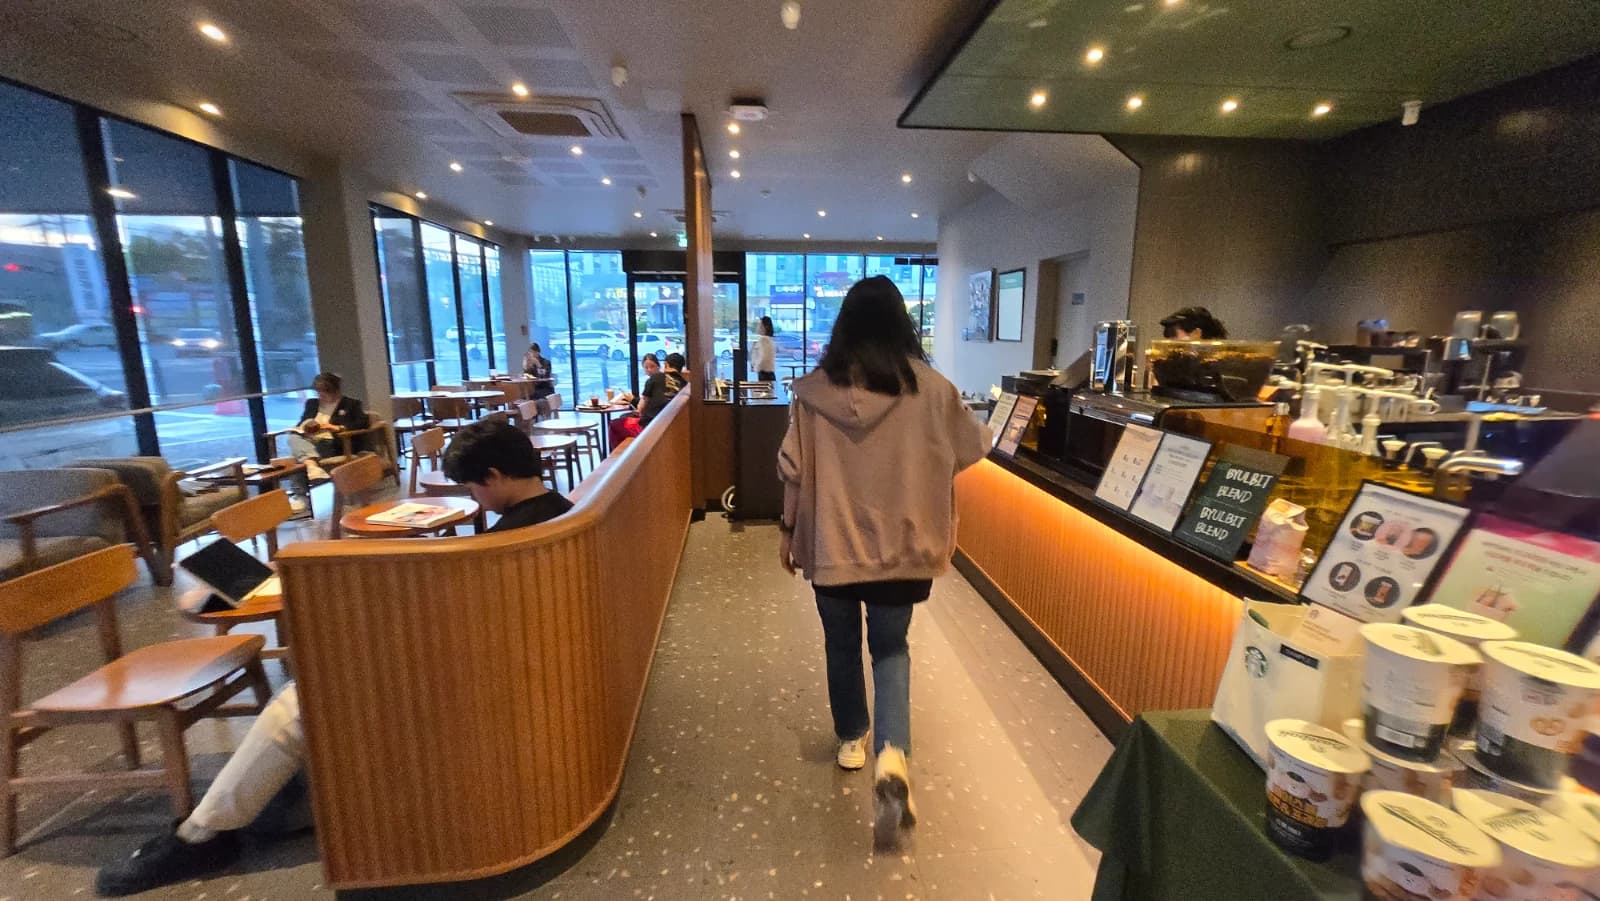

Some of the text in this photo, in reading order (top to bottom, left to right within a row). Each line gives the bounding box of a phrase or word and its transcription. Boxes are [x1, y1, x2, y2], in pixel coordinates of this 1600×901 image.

[1226, 468, 1273, 488] BYULBIT
[1216, 485, 1252, 503] BLEND
[1200, 506, 1247, 528] BYULBIT
[1194, 521, 1229, 540] BLEND
